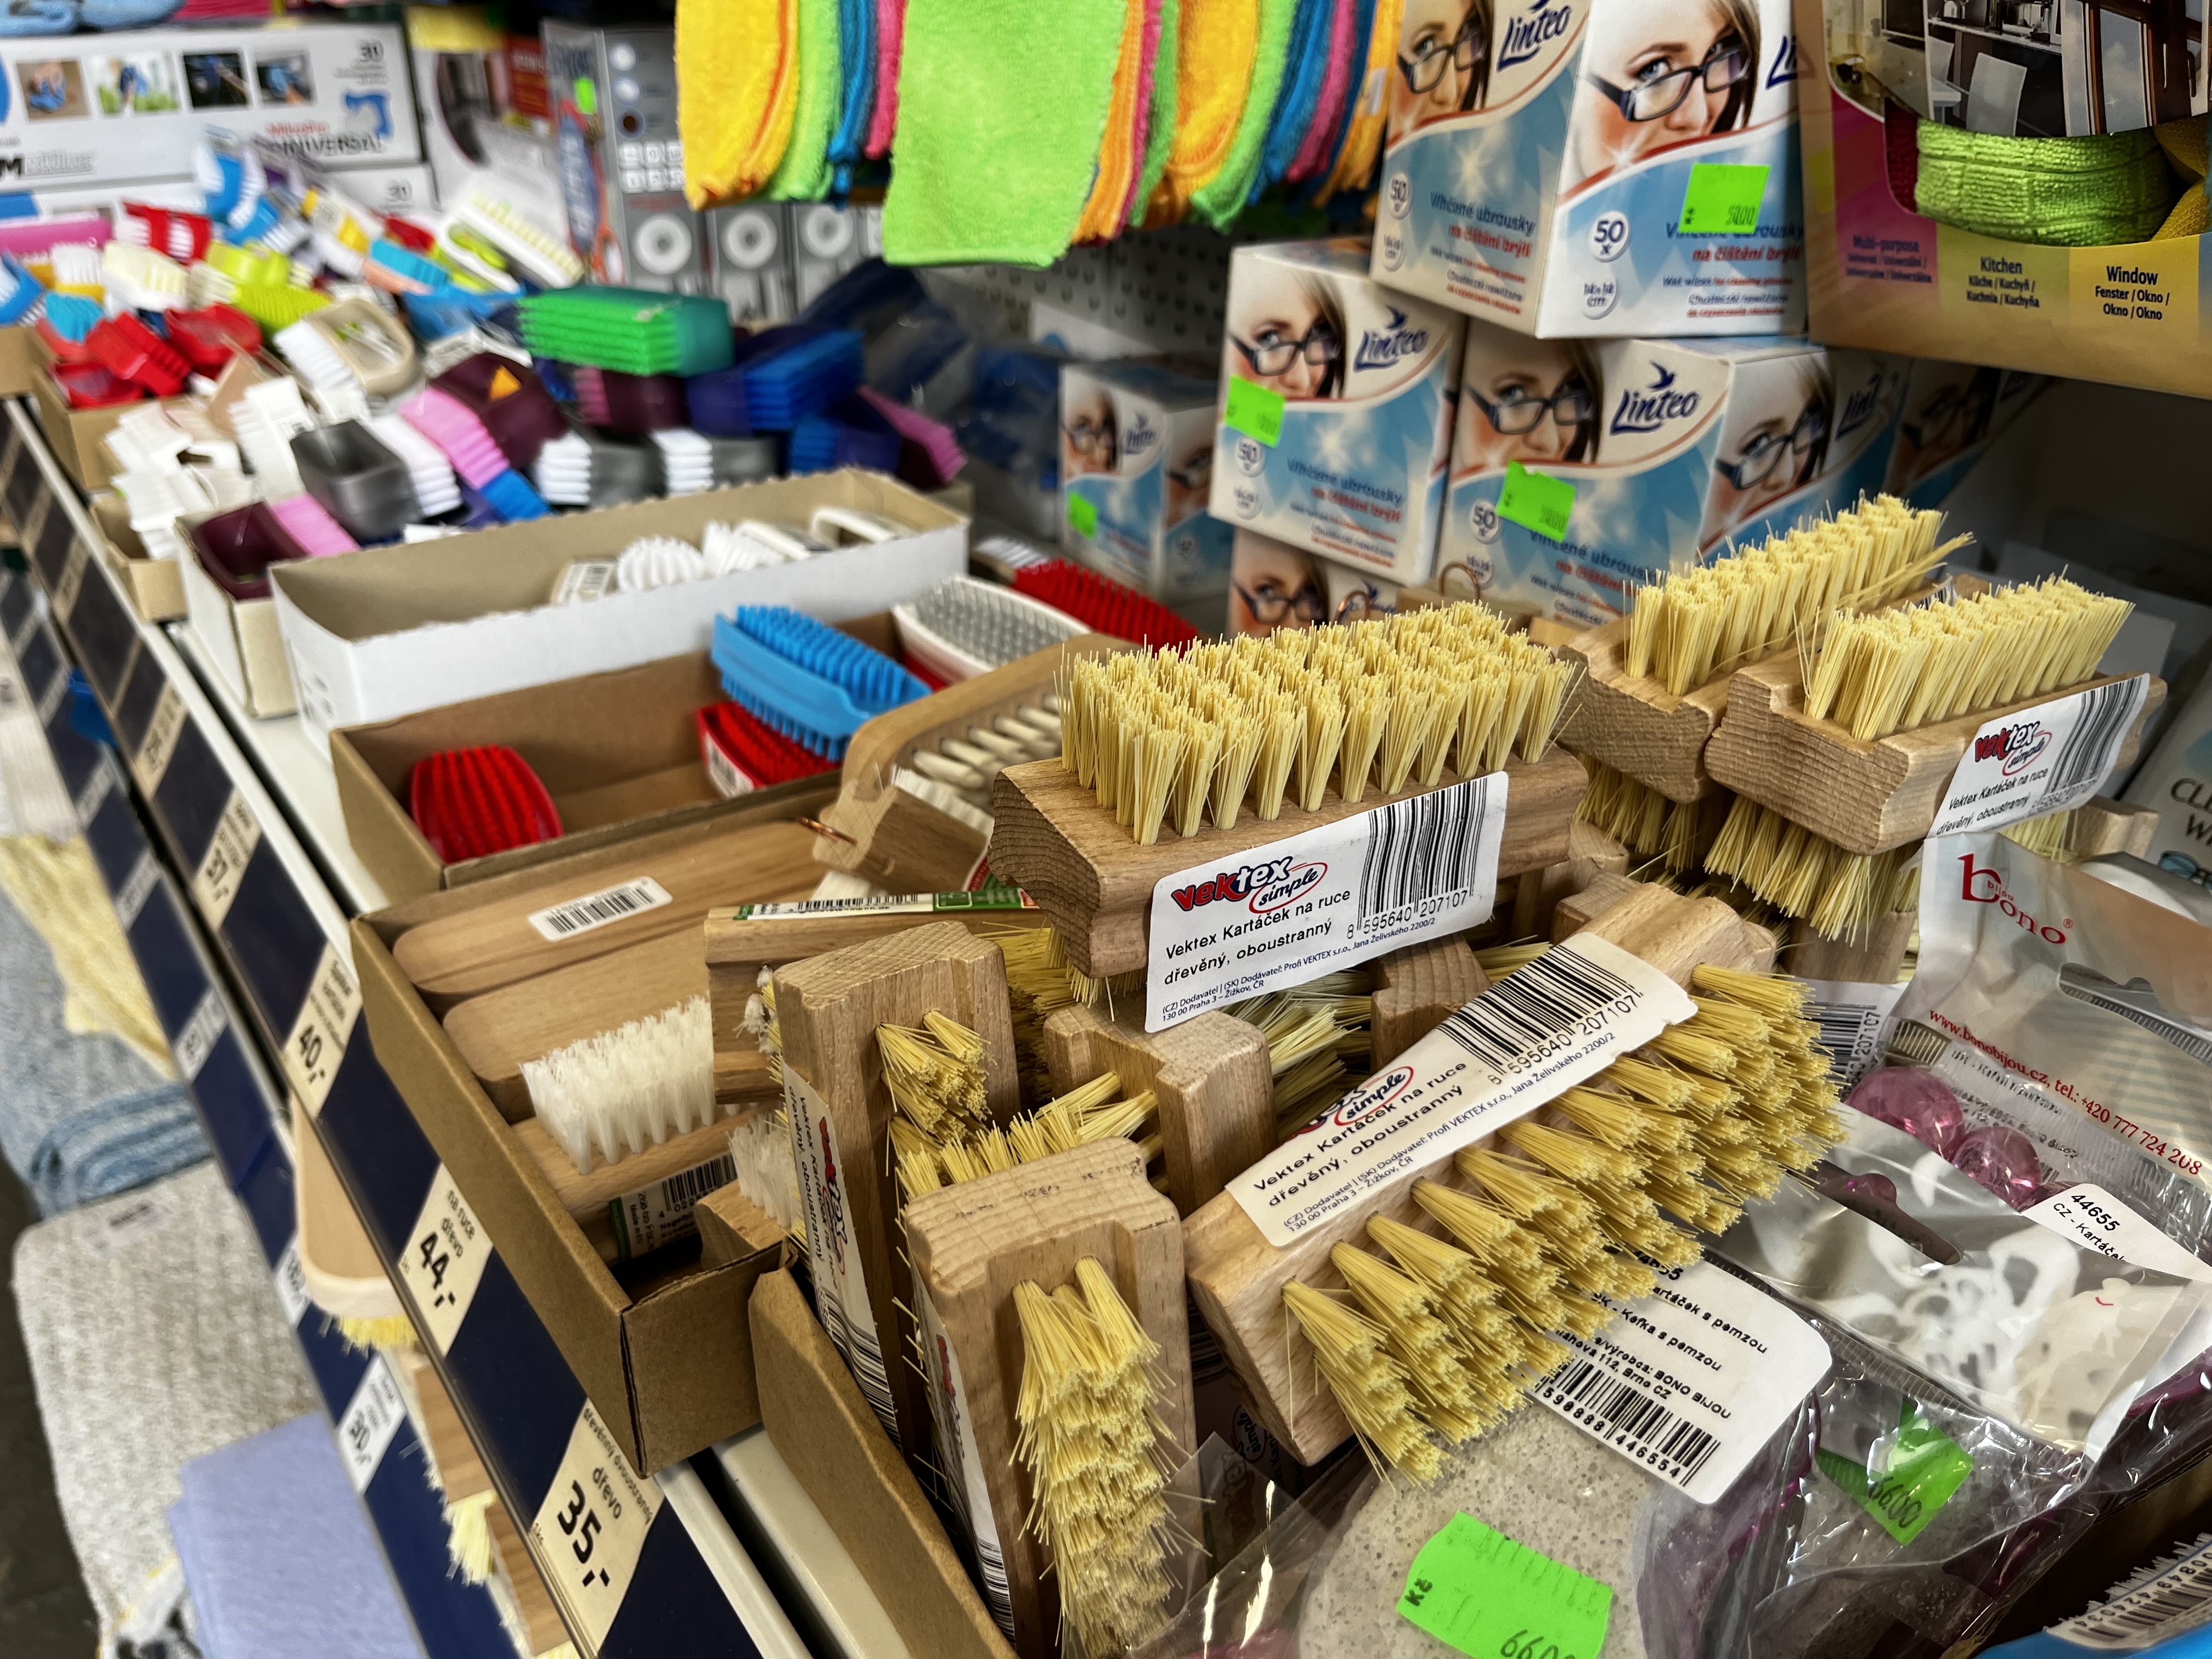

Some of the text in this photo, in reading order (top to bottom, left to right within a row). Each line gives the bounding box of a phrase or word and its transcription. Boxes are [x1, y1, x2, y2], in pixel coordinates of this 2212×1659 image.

[1497, 5, 1572, 72] Linteo
[1594, 220, 1624, 243] 50
[1980, 257, 2023, 274] Kitchen
[2106, 266, 2158, 285] Window
[2095, 286, 2129, 301] Fenster
[2137, 289, 2164, 303] Okno
[2103, 303, 2129, 317] Okno
[2136, 306, 2163, 320] Okno
[1353, 329, 1428, 373] Linteo
[1610, 388, 1701, 436] Linteo
[1472, 505, 1496, 529] 50
[1975, 720, 2040, 763] vektex
[1948, 793, 1978, 811] Vektex
[1980, 778, 2018, 800] Kartáček
[1171, 856, 1293, 911] vektex
[1258, 867, 1319, 906] simple
[1988, 879, 2014, 901] bijou
[1166, 890, 1351, 959] Vektex Kartáček na ruce
[1346, 890, 1468, 939] 8 595640 207107
[1163, 1001, 1178, 1014] (CZ)
[1180, 985, 1218, 1006] Dodavatel
[1224, 979, 1238, 991] (SK)
[1284, 960, 1301, 972] Profi
[1303, 950, 1332, 966] VEKTEX
[1353, 939, 1369, 950] Jana
[1371, 926, 1409, 943] Želivského
[1410, 917, 1435, 931] 2200/2
[1164, 918, 1331, 985] dřevěný, oboustranný
[1163, 1011, 1177, 1022] 130
[1180, 1007, 1188, 1017] 00
[1189, 999, 1210, 1012] Praha
[1224, 984, 1251, 998] Žižkov,
[1253, 979, 1264, 990] ČR
[1487, 995, 1639, 1086] 8 595640 207107
[1346, 1071, 1406, 1120] simple
[1929, 1009, 2051, 1088] www.bonobijou.cz,
[2055, 1079, 2080, 1103] tel.:
[2081, 1096, 2111, 1124] +420
[2114, 1114, 2140, 1138] 777
[2140, 1131, 2168, 1156] 724
[2167, 1148, 2203, 1176] 208
[1253, 1153, 1314, 1191] Vektex
[1317, 1102, 1396, 1153] Kartáček
[1402, 1087, 1424, 1105] na
[1426, 1062, 1467, 1088] ruce
[1284, 1212, 1304, 1227] (CZ)
[1304, 1182, 1352, 1214] Dodavatel
[1357, 1167, 1377, 1182] (SK)
[1426, 1124, 1451, 1141] Profi
[1450, 1103, 1487, 1128] VEKTEX
[1511, 1079, 1534, 1096] Jana
[1532, 1051, 1582, 1083] Želivského
[1582, 1032, 1616, 1055] 2200/2
[1351, 1084, 1463, 1156] oboustranný
[1289, 1219, 1307, 1232] 130
[1308, 1211, 1321, 1221] 00
[1322, 1195, 1350, 1214] Praha
[1365, 1165, 1399, 1188] Žižkov,
[1398, 1156, 1414, 1167] ČR
[2052, 1202, 2072, 1218] CZ
[2071, 1194, 2120, 1232] 44655
[1650, 1285, 1768, 1354] artáček s pomzou
[1657, 1330, 1667, 1340] s
[1666, 1335, 1722, 1372] pomzou
[1622, 1367, 1652, 1390] Brno
[1652, 1385, 1672, 1400] CZ
[1653, 1370, 1691, 1396] BONO
[1690, 1391, 1732, 1420] BIJOU
[1615, 1434, 1681, 1479] 446554
[592, 1466, 622, 1520] dřevo
